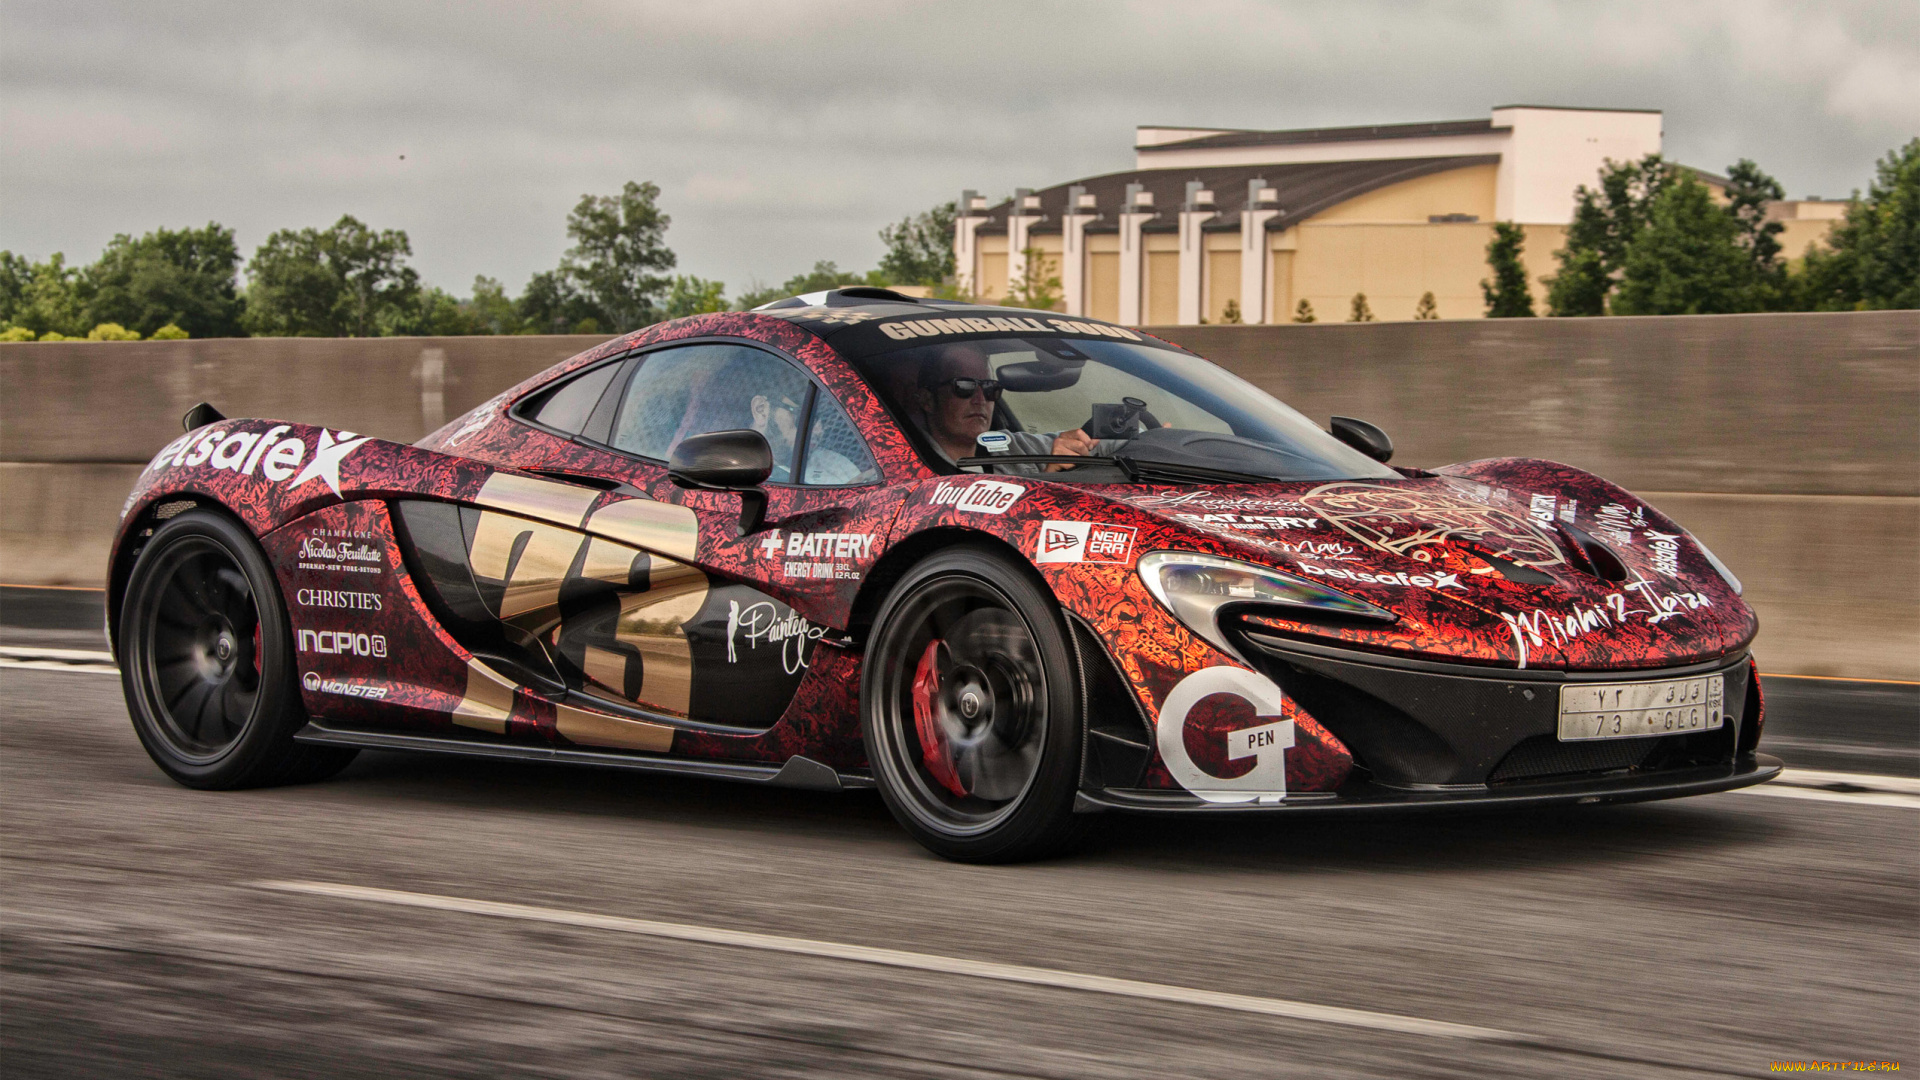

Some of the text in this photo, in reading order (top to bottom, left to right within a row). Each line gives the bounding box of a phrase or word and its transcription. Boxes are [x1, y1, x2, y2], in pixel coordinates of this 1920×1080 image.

[879, 317, 1143, 341] GUMBALL 3000
[929, 481, 1018, 510] YouTube
[312, 528, 372, 539] CHAMPAGNE
[1091, 531, 1128, 543] NEW
[299, 538, 381, 562] Nicolas Feuillatte
[786, 533, 876, 558] BATTERY
[1089, 542, 1126, 554] ERA
[784, 562, 834, 579] ENERGY DRINK
[1297, 561, 1434, 587] betsafe
[297, 588, 382, 610] CHRISTIE'S
[298, 629, 371, 656] INCIPIO
[1501, 603, 1613, 669] Miami
[321, 680, 388, 698] MONSTER
[1664, 708, 1698, 730] GLG
[1248, 730, 1275, 749] PEN
